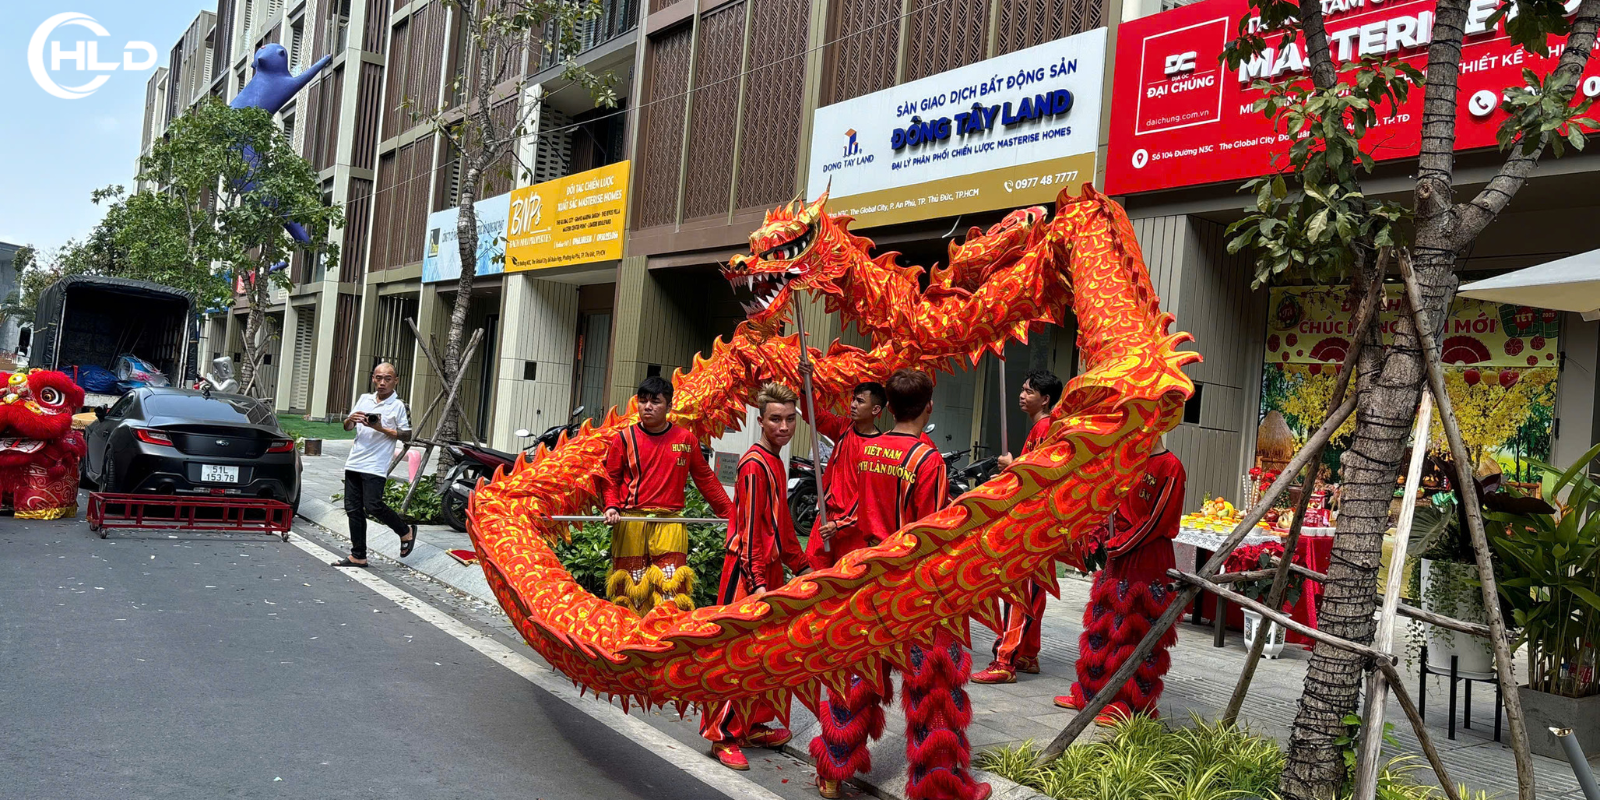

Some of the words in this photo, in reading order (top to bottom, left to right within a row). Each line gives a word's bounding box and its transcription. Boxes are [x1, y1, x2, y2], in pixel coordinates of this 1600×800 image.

[1459, 52, 1498, 74] HIẾT
[896, 101, 917, 117] SÀN
[920, 93, 946, 111] GIAO
[950, 85, 977, 105] DỊCH
[980, 74, 1004, 96] BẤT
[1006, 68, 1045, 90] ĐỘNG
[1049, 57, 1077, 78] SẢN
[1147, 84, 1168, 98] ĐẠI
[1171, 75, 1215, 93] CHÚNG
[954, 101, 1001, 136] TÂY
[1001, 88, 1074, 127] LAND
[1146, 109, 1210, 126] daichung.com.vn
[997, 133, 1040, 149] MASTERISE
[1042, 126, 1071, 140] HOMES
[1162, 150, 1173, 159] 104
[1219, 142, 1233, 151] The
[1233, 137, 1259, 148] Global
[1259, 135, 1275, 145] City
[823, 161, 842, 173] DONG
[844, 158, 856, 168] TAY
[856, 154, 875, 166] LAND
[1015, 176, 1039, 190] 0977
[1039, 174, 1053, 186] 48
[1054, 170, 1078, 183] 7777
[1299, 315, 1344, 334] CHÚC
[1454, 311, 1496, 334] MỚI
[882, 448, 903, 460] NAM
[212, 465, 229, 474] 51L
